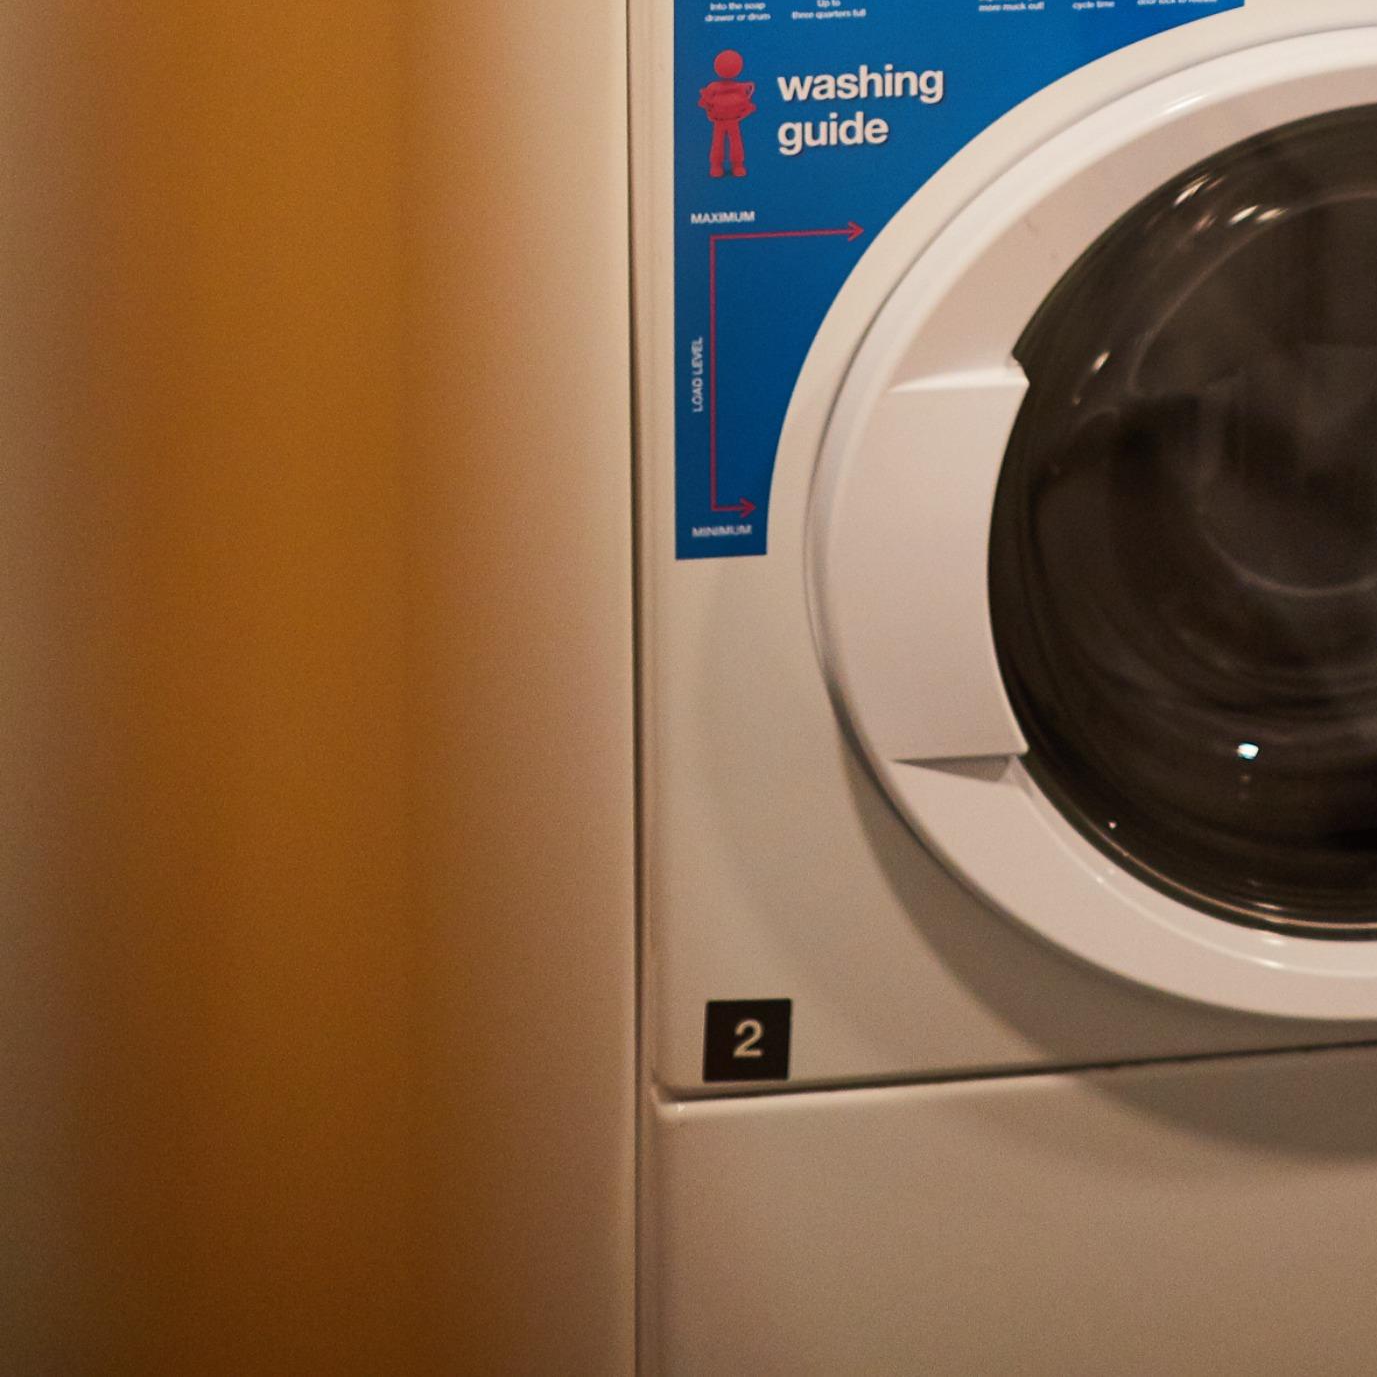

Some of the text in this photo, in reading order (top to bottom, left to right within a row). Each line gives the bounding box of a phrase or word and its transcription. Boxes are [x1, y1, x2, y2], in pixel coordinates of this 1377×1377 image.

[777, 64, 943, 104] washing
[777, 112, 889, 156] guide
[690, 211, 756, 224] MAXIMUM
[734, 1018, 764, 1057] 2
